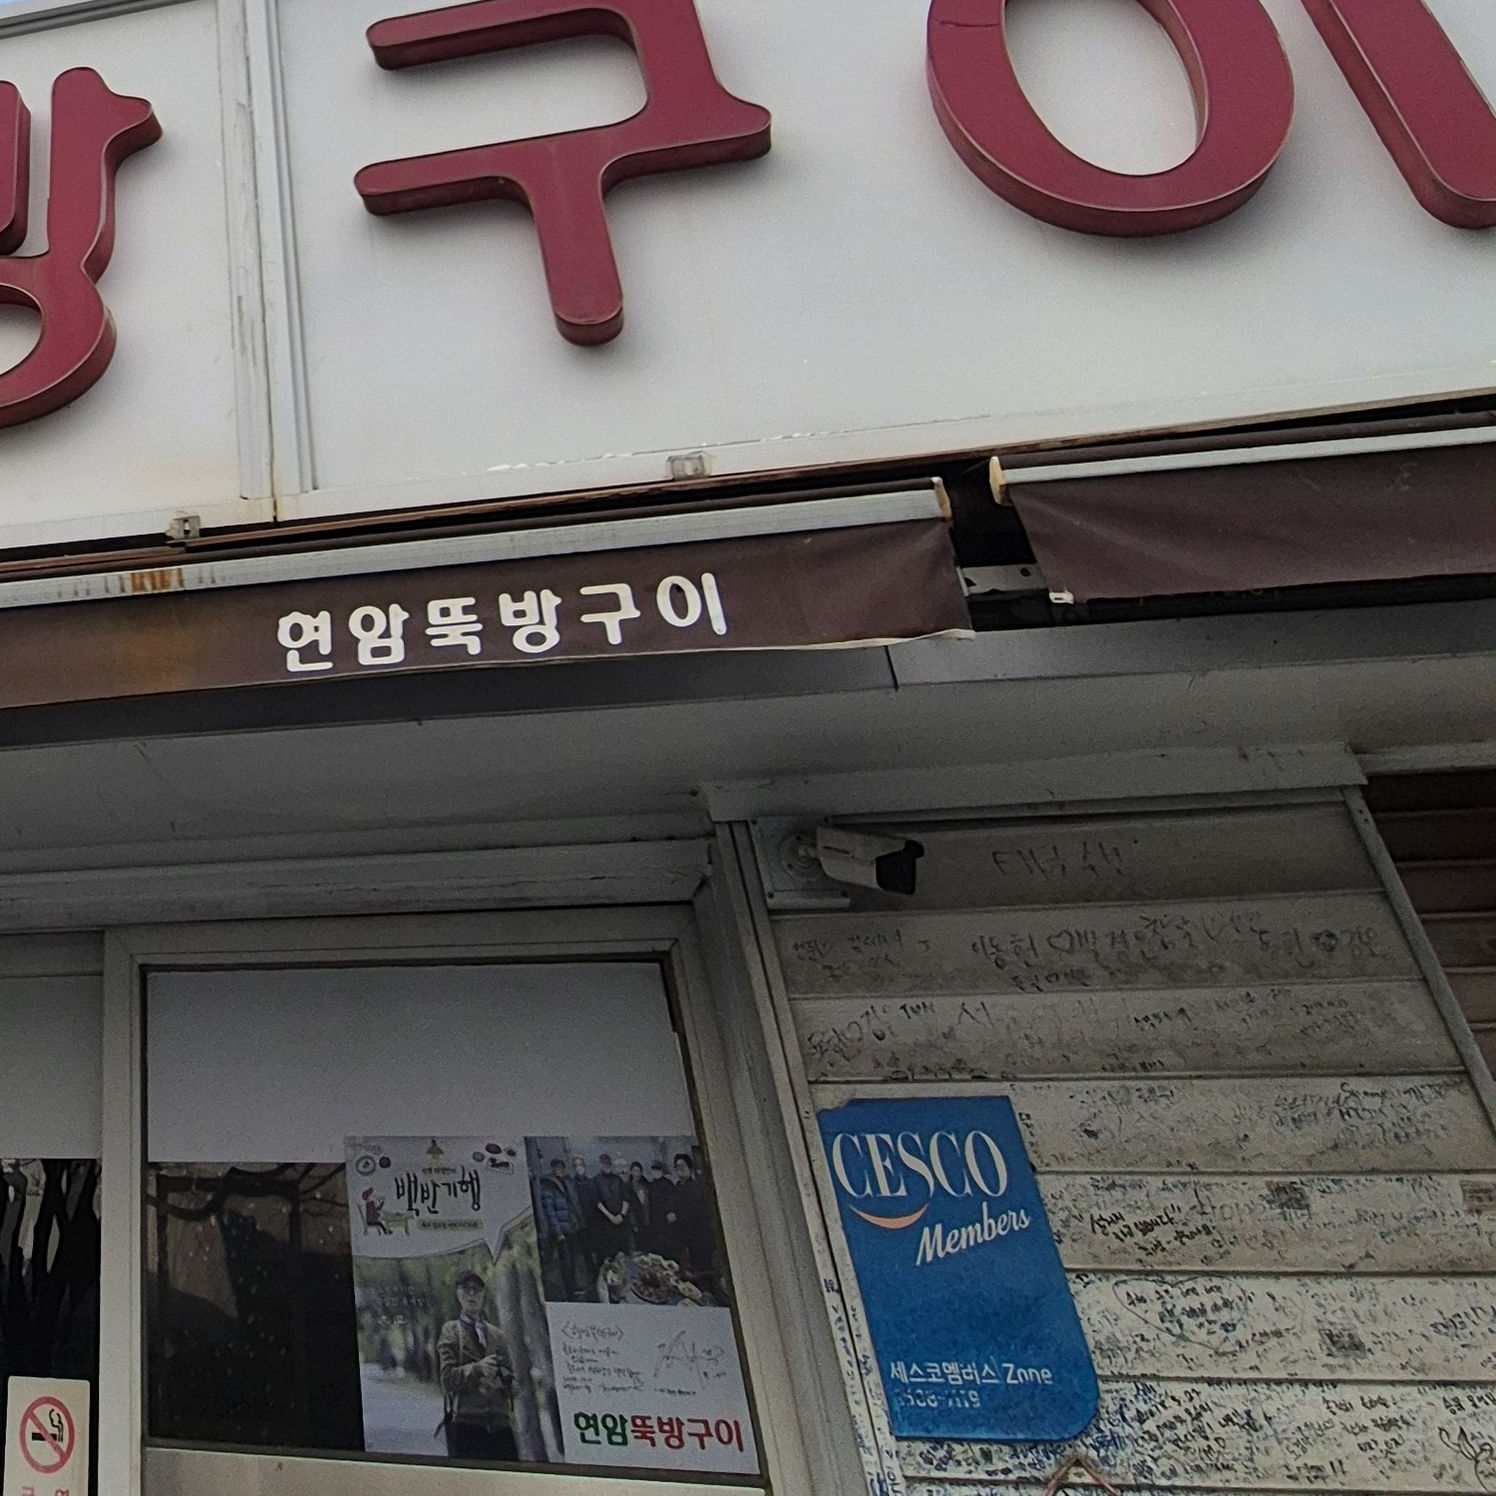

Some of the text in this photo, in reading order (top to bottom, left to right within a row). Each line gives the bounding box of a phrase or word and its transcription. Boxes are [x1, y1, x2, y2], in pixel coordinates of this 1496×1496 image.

[277, 572, 727, 672] 연암뚝방구이
[393, 1165, 481, 1216] 백반기행
[832, 1130, 1008, 1197] CESCO
[915, 1201, 1031, 1266] Members
[574, 1412, 744, 1452] 연암뚝방구이
